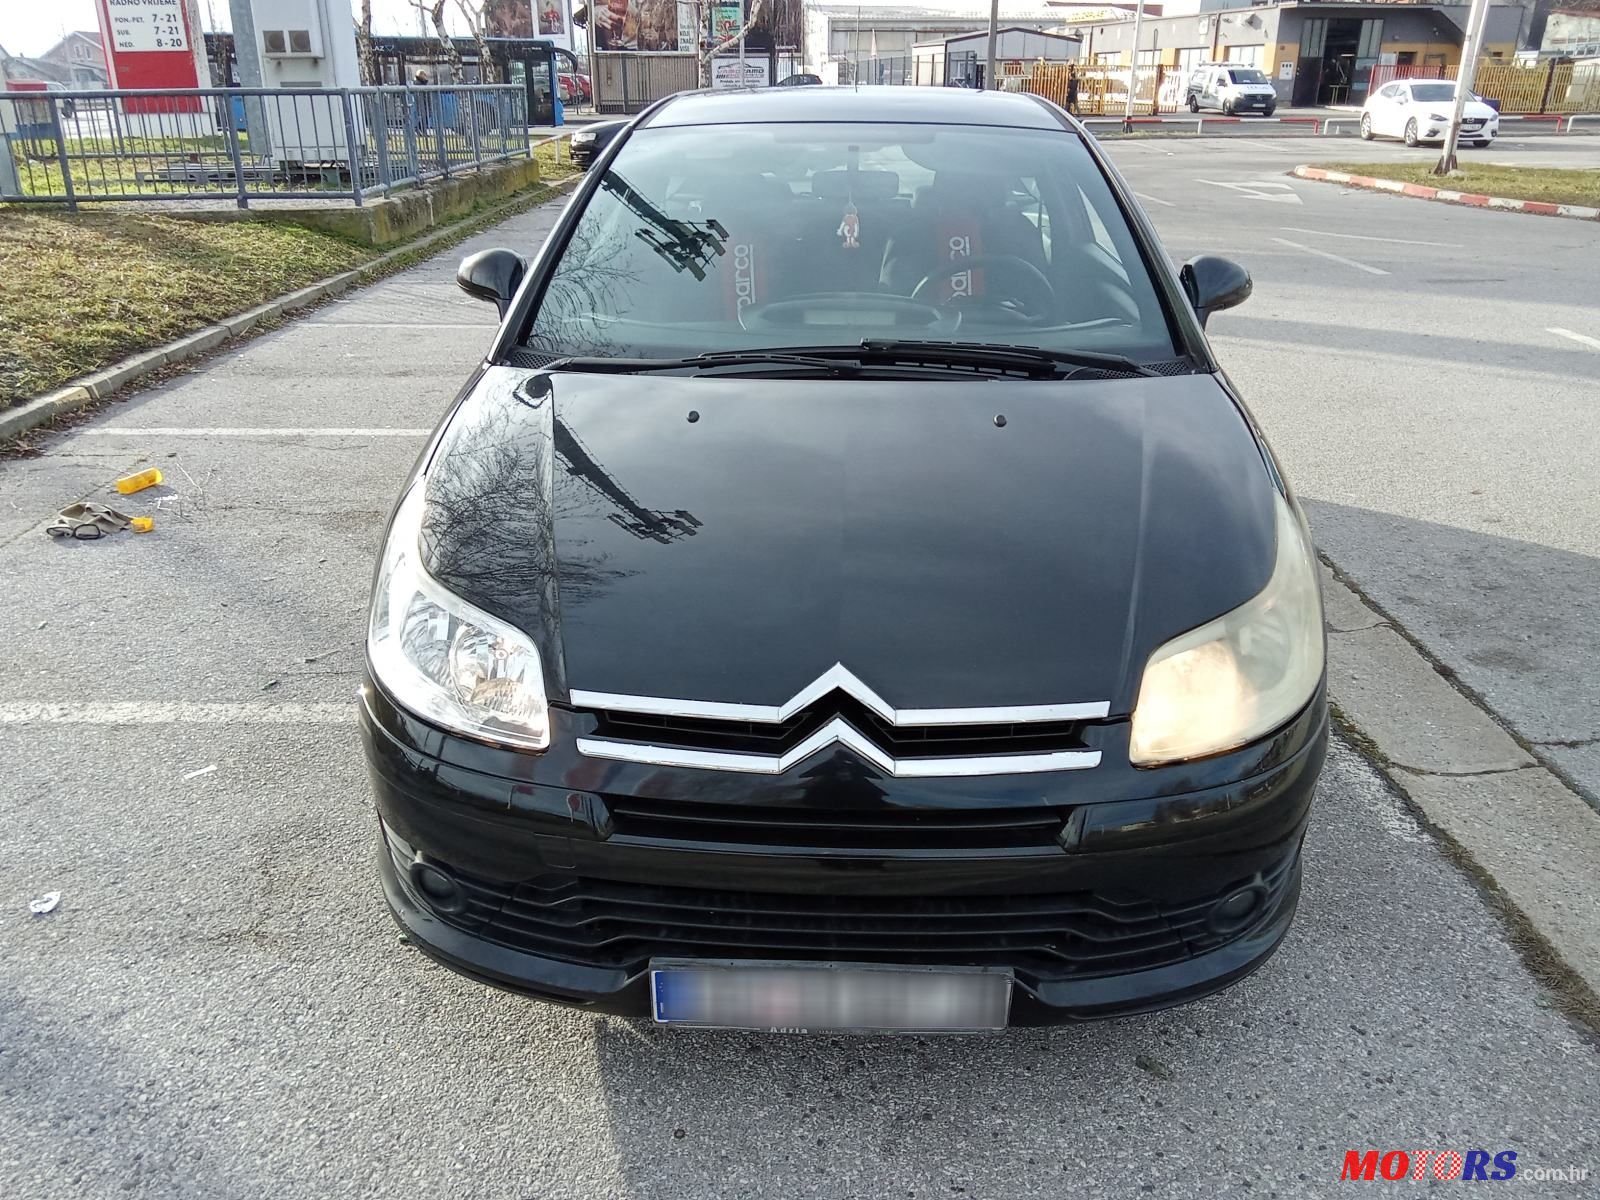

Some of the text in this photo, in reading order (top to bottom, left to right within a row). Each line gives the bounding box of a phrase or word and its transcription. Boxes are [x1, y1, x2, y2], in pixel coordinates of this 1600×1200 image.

[152, 14, 157, 22] 7
[165, 14, 177, 22] 21
[154, 26, 160, 35] 7
[167, 26, 179, 35] 21
[156, 39, 163, 47] 8
[170, 38, 182, 47] 20
[734, 244, 752, 307] parco
